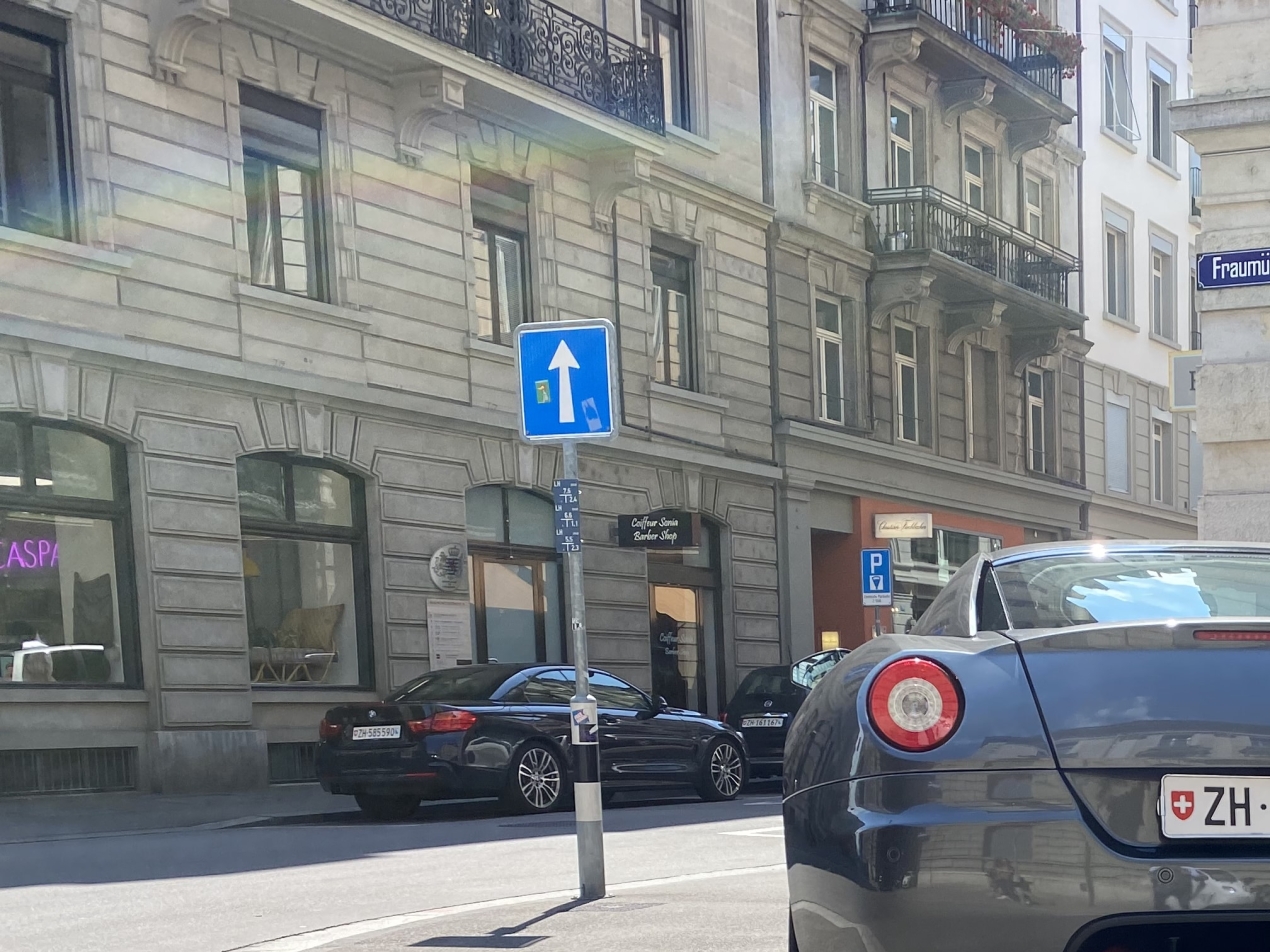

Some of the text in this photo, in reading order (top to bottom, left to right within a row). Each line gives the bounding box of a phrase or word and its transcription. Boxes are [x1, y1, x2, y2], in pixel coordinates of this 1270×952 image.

[631, 516, 679, 530] Coiffeur Sonia
[633, 529, 678, 545] Barber Shop
[870, 552, 883, 574] P
